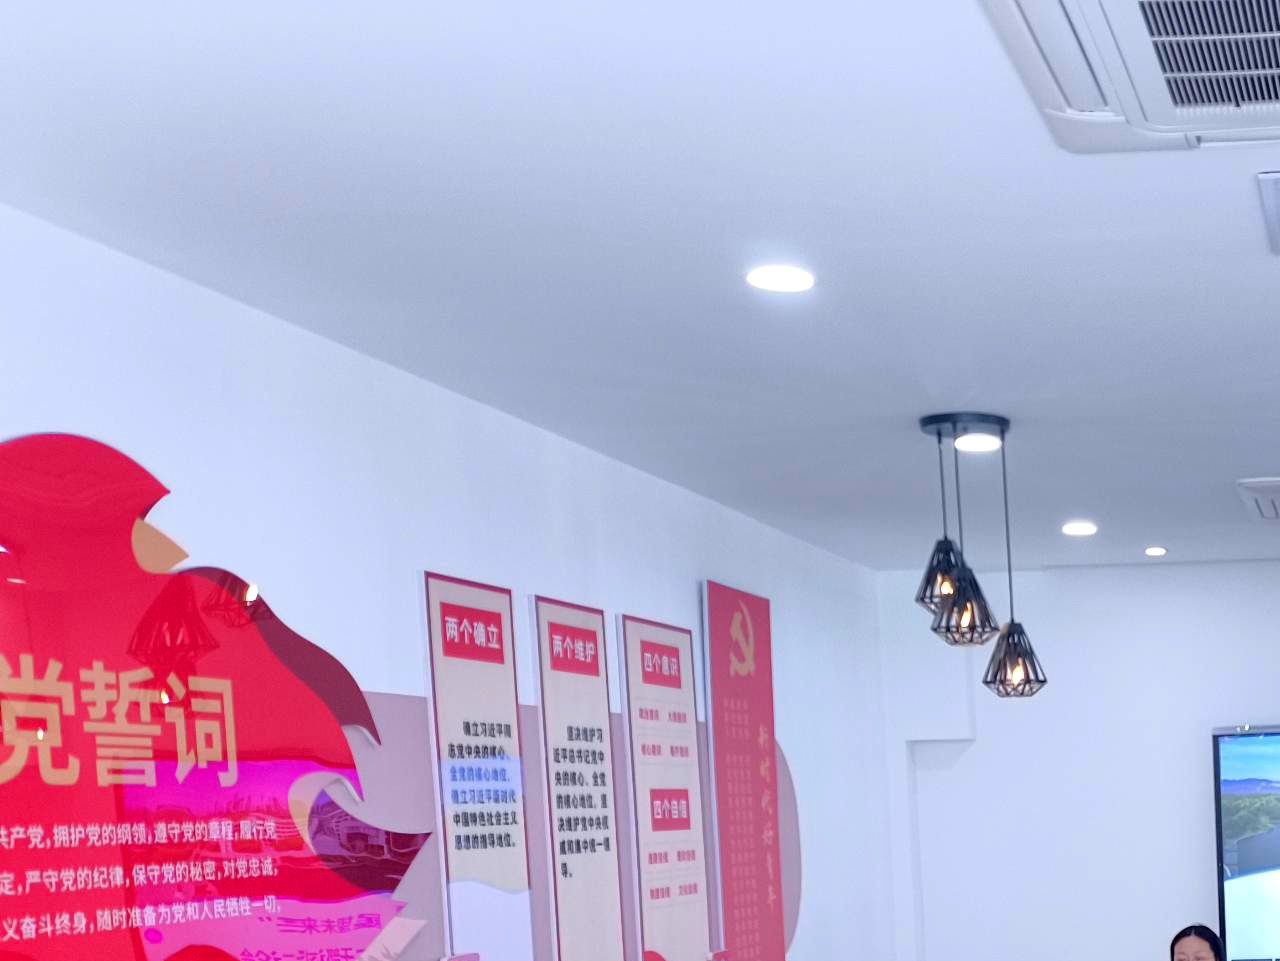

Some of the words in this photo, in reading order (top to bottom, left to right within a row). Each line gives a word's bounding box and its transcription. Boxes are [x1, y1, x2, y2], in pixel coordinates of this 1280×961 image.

[445, 616, 500, 649] 两个确立
[552, 634, 595, 663] 两个维护
[0, 653, 239, 787] 党誓词
